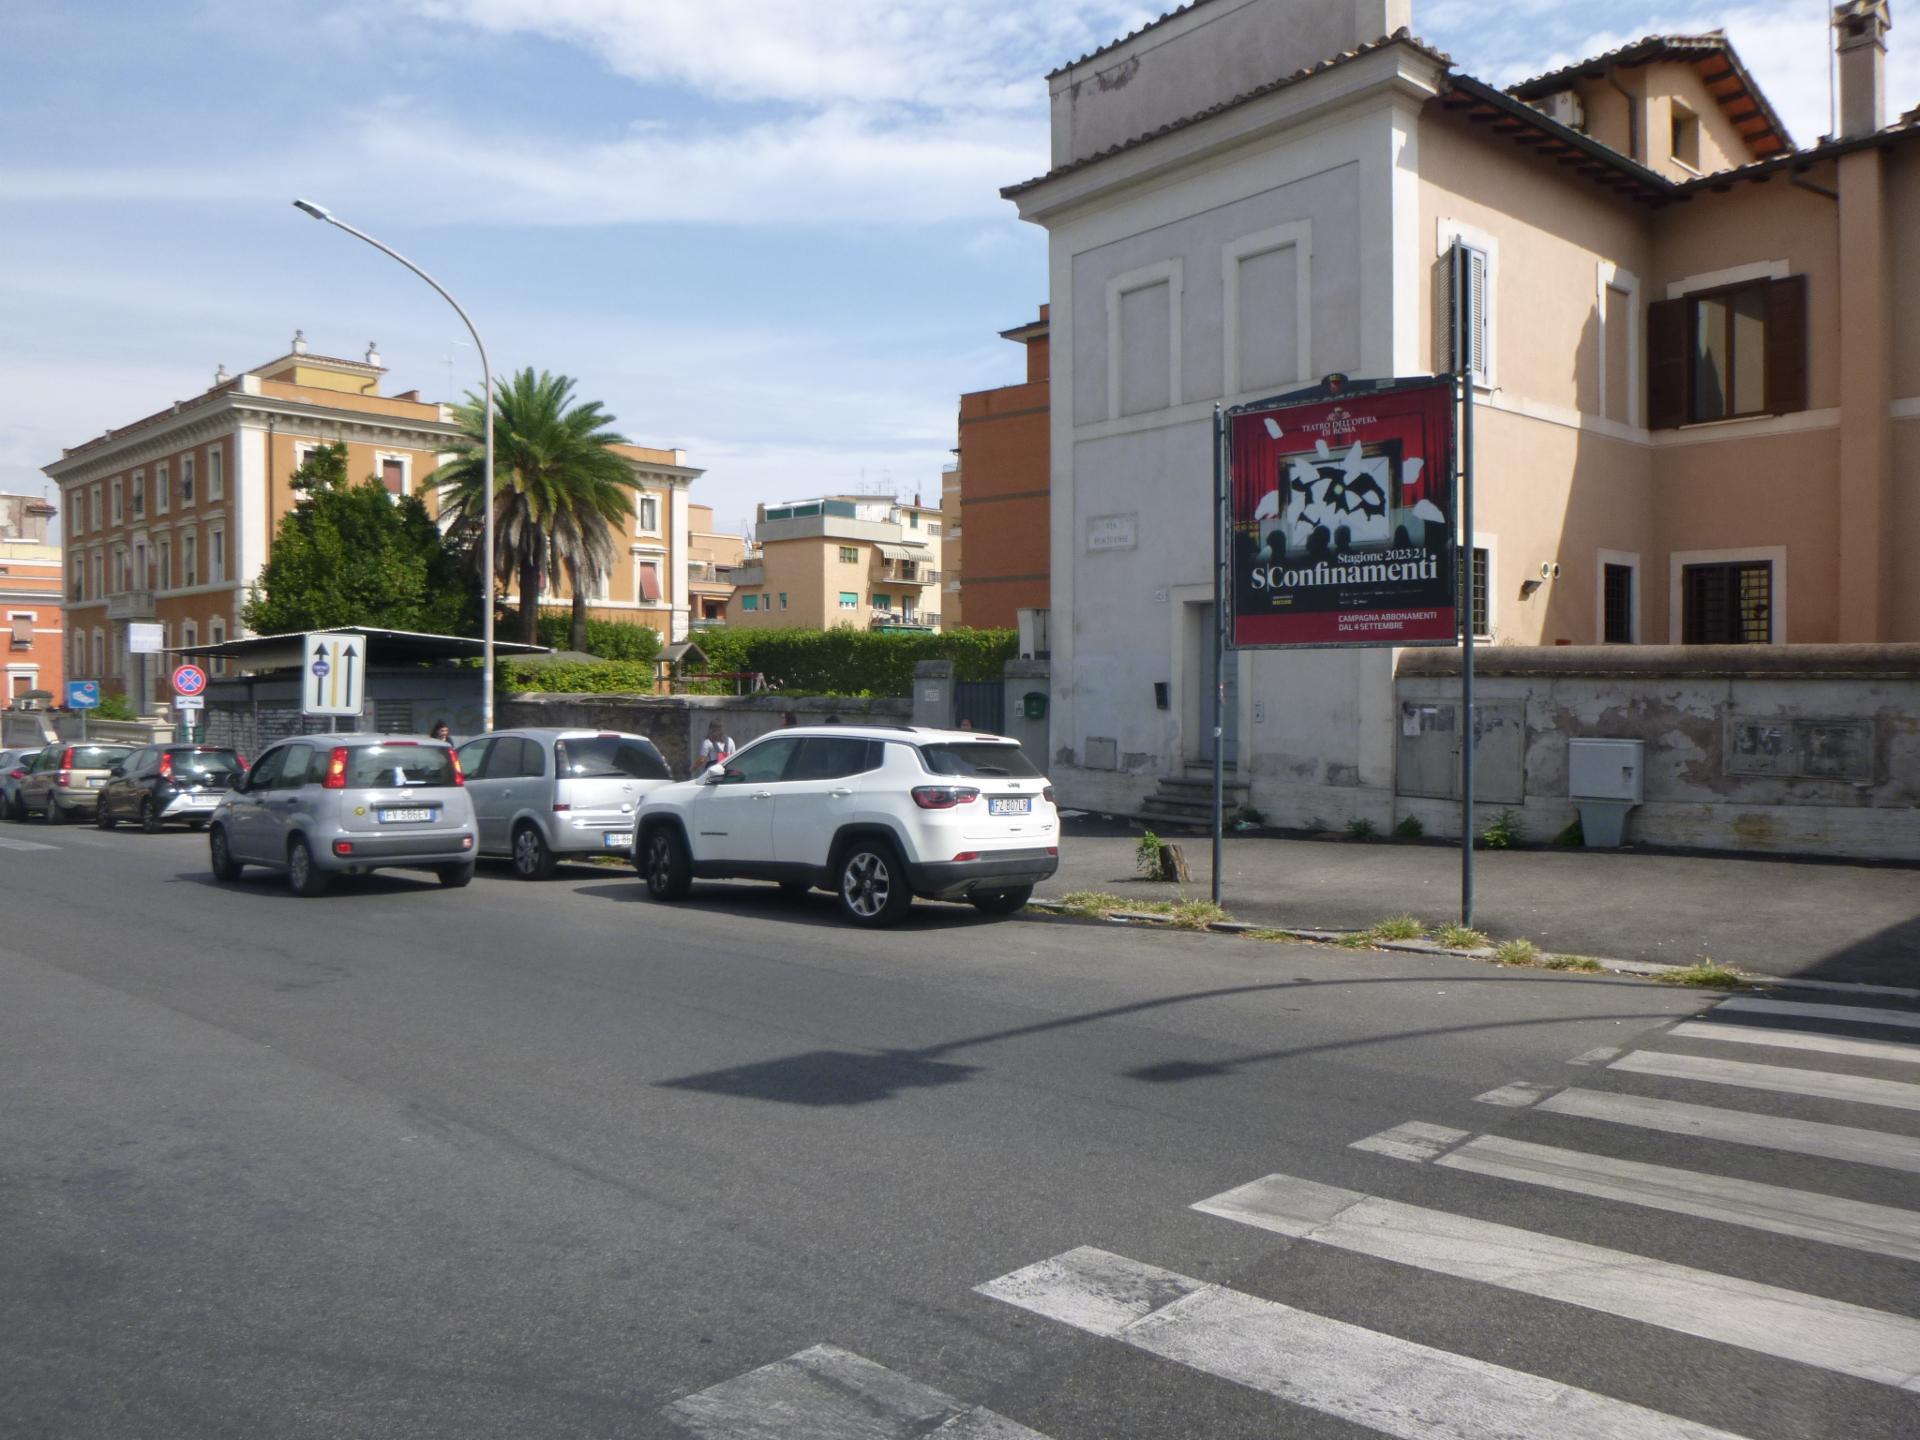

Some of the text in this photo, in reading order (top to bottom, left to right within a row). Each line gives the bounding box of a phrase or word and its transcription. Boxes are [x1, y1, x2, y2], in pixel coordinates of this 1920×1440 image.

[1302, 422, 1331, 433] TEATRO
[1322, 426, 1356, 437] DI ROMA
[1337, 550, 1383, 564] Stagione
[1338, 611, 1437, 623] CAMPAGNA ABBONAMENTI
[1338, 623, 1353, 631] DAL
[1359, 621, 1404, 631] SETTEMBRE
